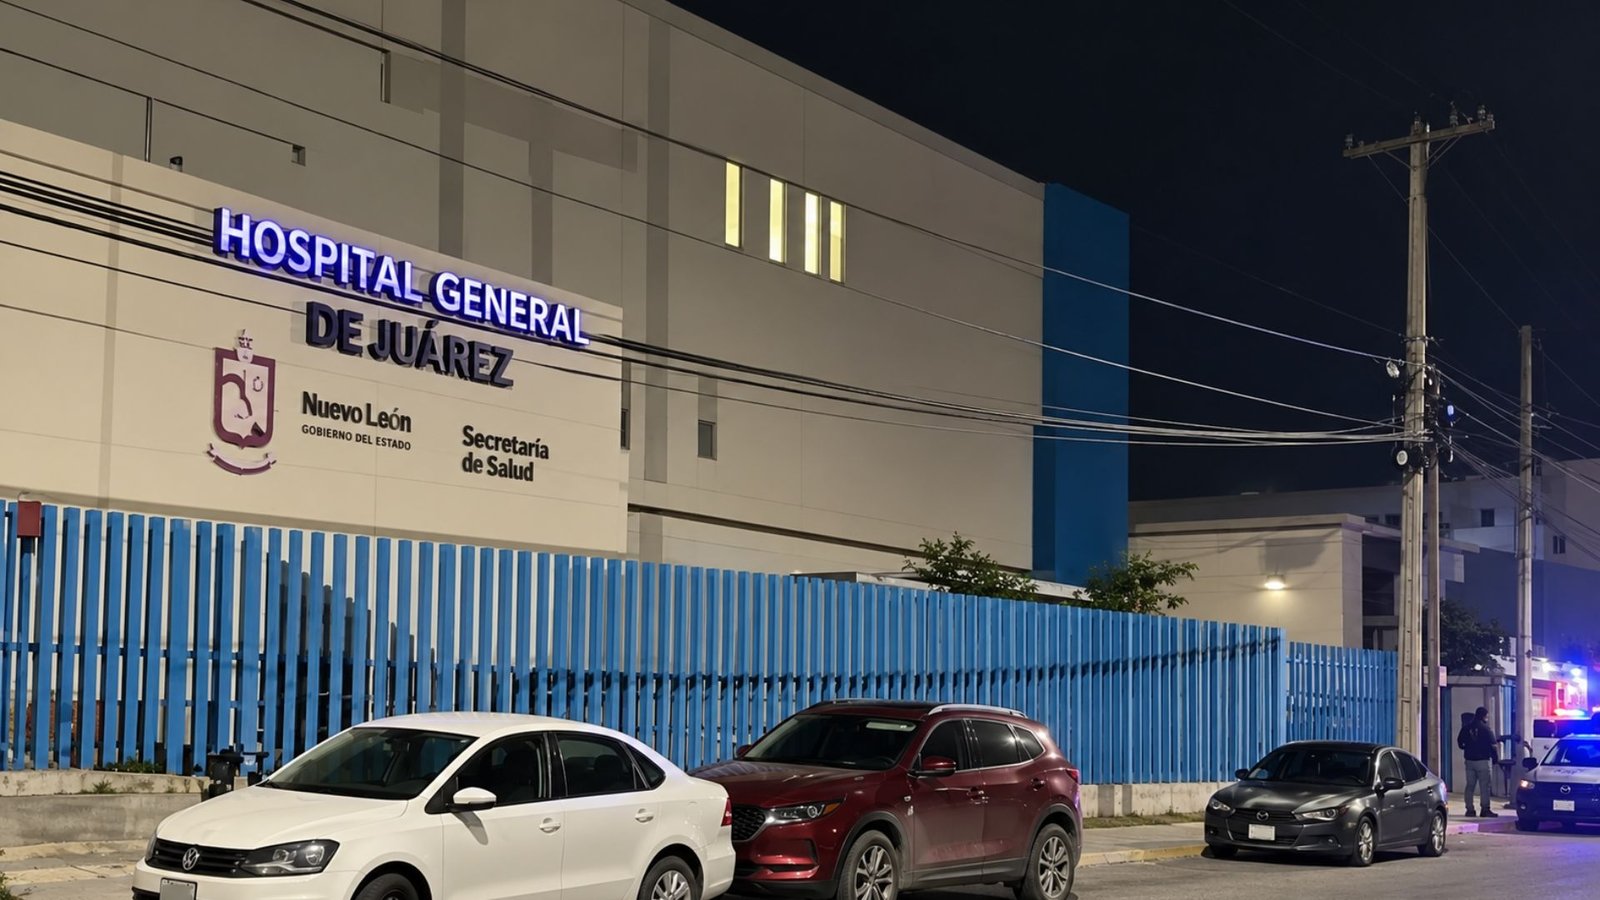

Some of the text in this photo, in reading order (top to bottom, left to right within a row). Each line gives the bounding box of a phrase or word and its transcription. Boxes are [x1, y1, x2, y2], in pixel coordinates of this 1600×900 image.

[214, 207, 591, 346] HOSPITAL GENERAL
[305, 301, 514, 388] DE JUÁREZ
[302, 391, 412, 433] Nuevo León
[301, 424, 411, 451] GOBIERNO DEL ESTADO
[462, 424, 549, 460] Secretaría
[462, 451, 534, 482] de Salud
